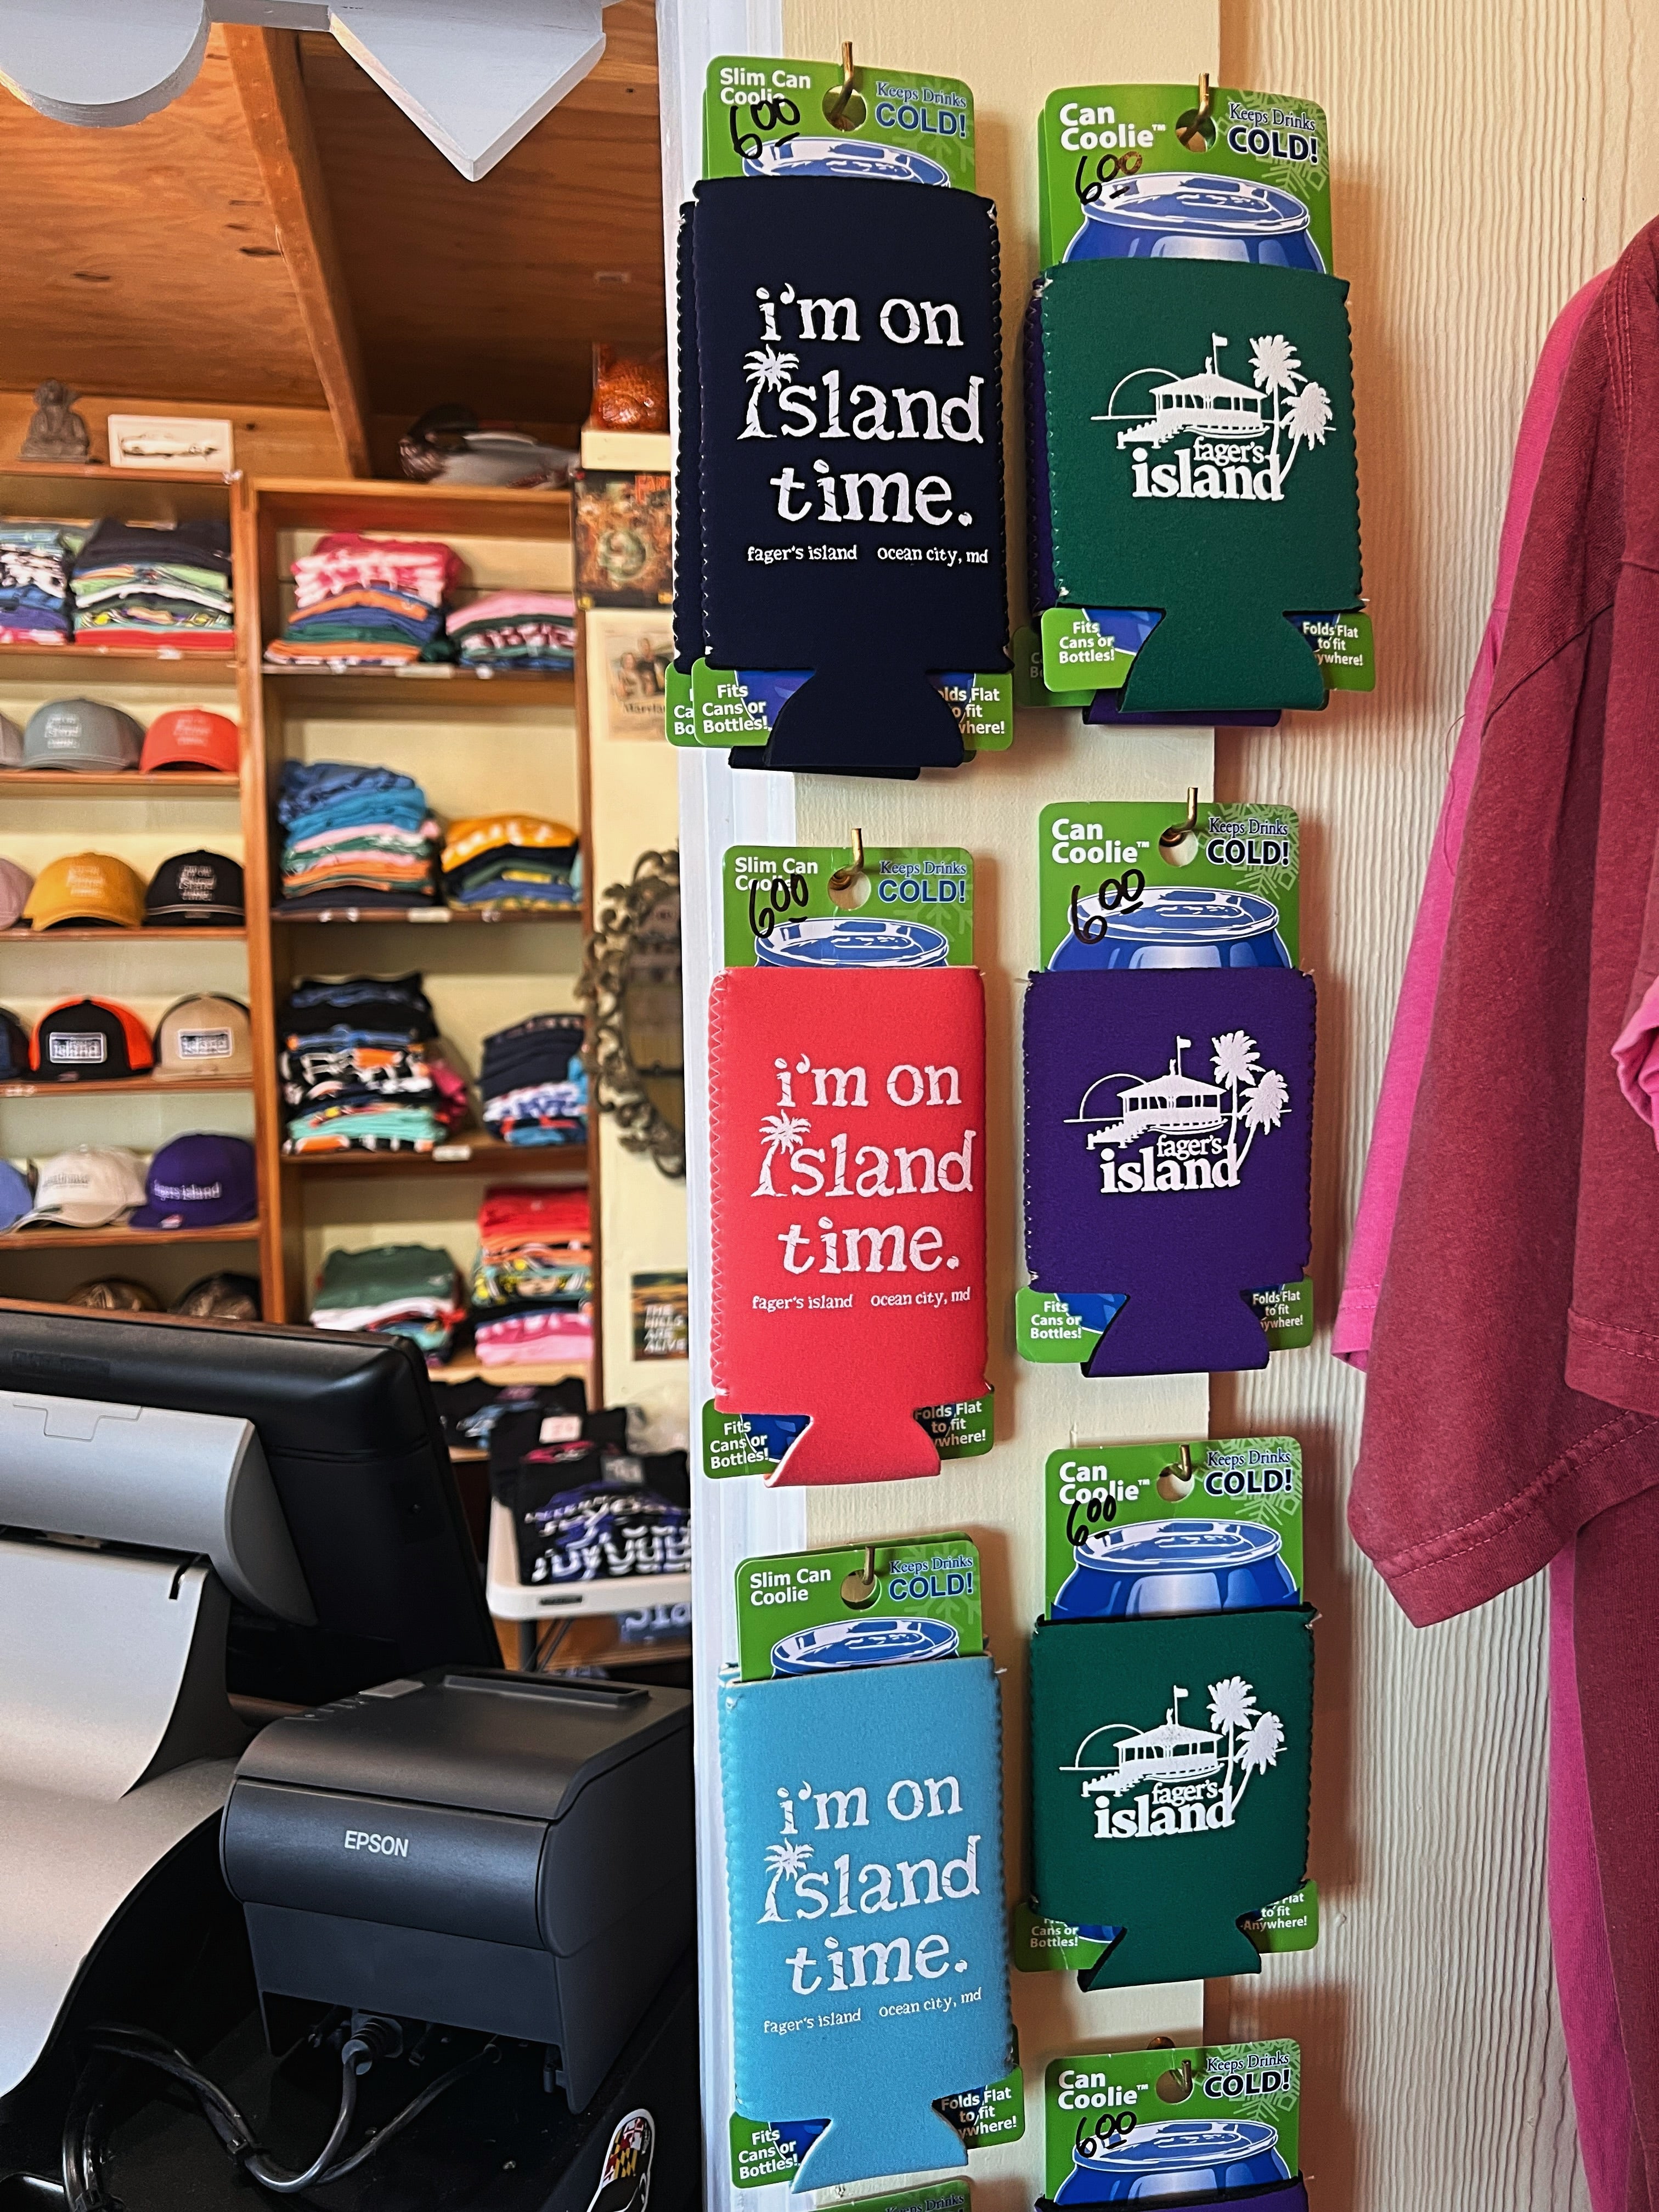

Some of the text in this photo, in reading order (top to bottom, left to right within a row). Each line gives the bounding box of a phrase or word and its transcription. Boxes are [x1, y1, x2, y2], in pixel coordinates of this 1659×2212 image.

[720, 67, 811, 89] Slim Can
[876, 82, 967, 109] Keeps Drinks
[875, 104, 967, 138] COLD!
[1060, 103, 1115, 126] Can
[1228, 102, 1316, 132] Keeps Drinks
[1227, 126, 1318, 164] COLD!
[756, 283, 964, 346] i'm on
[1193, 436, 1265, 465] fager's
[1132, 447, 1284, 501] island
[770, 460, 973, 526] time.
[747, 544, 857, 565] fager's island
[877, 547, 989, 567] ocean city, md
[1073, 621, 1100, 634] Fits
[1302, 621, 1359, 638] Folds Flat
[1059, 636, 1115, 649] Cans or
[1317, 637, 1346, 651] to fit
[1059, 649, 1115, 664] Bottles!
[717, 684, 748, 698] Fits
[970, 687, 1000, 702] Flat
[702, 701, 766, 716] Cans or
[965, 703, 983, 718] fit
[702, 715, 769, 734] Bottles!
[1051, 817, 1103, 840] Can
[1209, 817, 1288, 838] Keeps Drinks
[1205, 838, 1290, 867] COLD!
[735, 856, 818, 874] Slim Can
[879, 860, 966, 878] Keeps Drinks
[878, 878, 966, 904] COLD!
[774, 1053, 962, 1107] i'm on
[1156, 1135, 1223, 1160] fager's
[1101, 1144, 1241, 1193] island
[777, 1216, 960, 1274] time.
[752, 1294, 853, 1313] fager's island
[870, 1286, 971, 1309] ocean city, md
[1044, 1301, 1069, 1313] Fits
[1252, 1290, 1301, 1305] Folds Flat
[1031, 1314, 1082, 1326] Cans or
[1265, 1303, 1289, 1316] to fit
[1030, 1327, 1082, 1339] Bottles!
[955, 1401, 982, 1415] Flat
[724, 1421, 752, 1435] Fits
[932, 1418, 967, 1434] to fit
[710, 1434, 768, 1453] Cans or
[710, 1447, 769, 1469] Bottles!
[1207, 1447, 1291, 1470] Keeps Drinks
[1059, 1461, 1108, 1483] Can
[1204, 1468, 1293, 1497] COLD!
[889, 1554, 973, 1575] Keeps Drinks
[750, 1567, 831, 1589] Slim Can
[888, 1571, 974, 1602] COLD!
[751, 1588, 809, 1606] Coolie
[1152, 1780, 1218, 1807] fager's
[777, 1776, 963, 1835] i'm on
[1094, 1787, 1235, 1839] island
[344, 1829, 409, 1857] EPSON
[1261, 1906, 1290, 1917] to fit
[1031, 1926, 1079, 1936] Cans or
[1243, 1915, 1308, 1932] Anywhere!
[1030, 1936, 1079, 1948] Bottles!
[785, 1934, 968, 1995] time.
[879, 1987, 982, 2017] ocean city, md
[764, 2008, 861, 2035] fager's island
[1207, 2051, 1289, 2074] Keeps Drinks
[1057, 2069, 1106, 2090] Can
[1203, 2068, 1291, 2100] COLD!
[941, 2086, 1012, 2111] Folds Flat
[960, 2105, 995, 2123] to fit
[752, 2130, 780, 2145] Fits
[738, 2140, 796, 2163] Cans or
[739, 2153, 798, 2180] Bottles!
